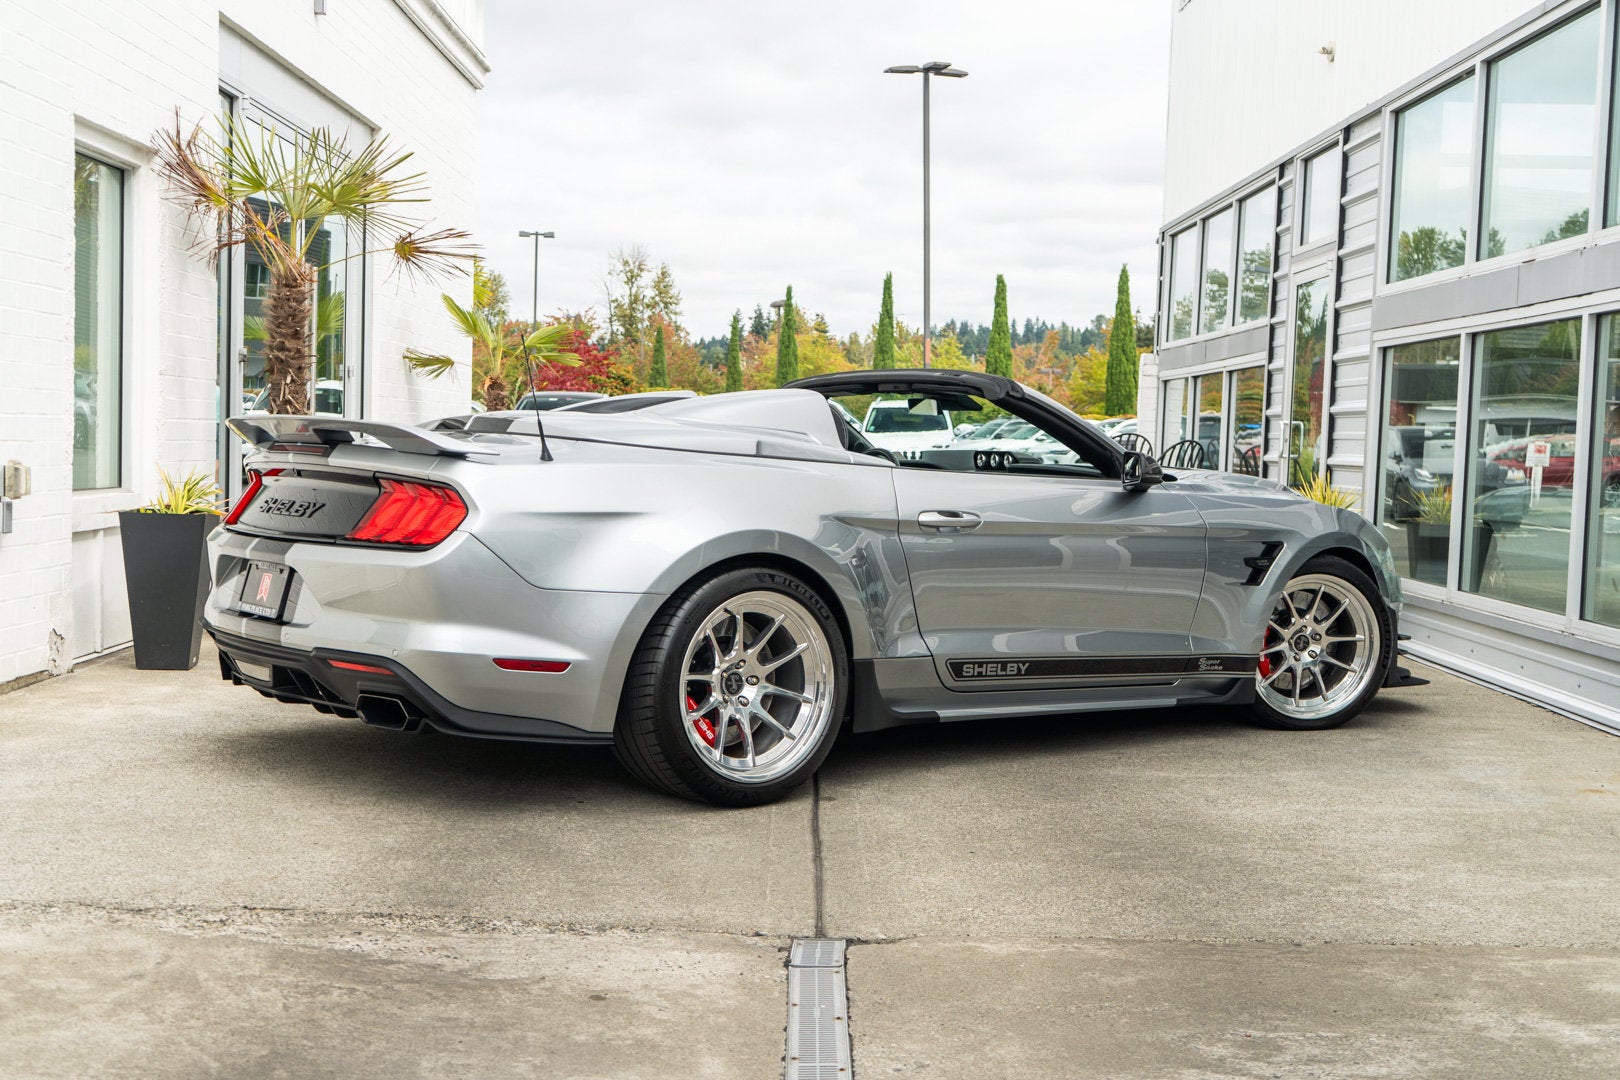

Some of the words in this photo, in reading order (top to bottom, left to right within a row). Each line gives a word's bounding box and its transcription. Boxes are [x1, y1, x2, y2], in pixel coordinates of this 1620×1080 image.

[260, 498, 326, 518] SHELBY
[774, 576, 830, 620] MICHELIN
[962, 662, 1030, 676] SHELBY
